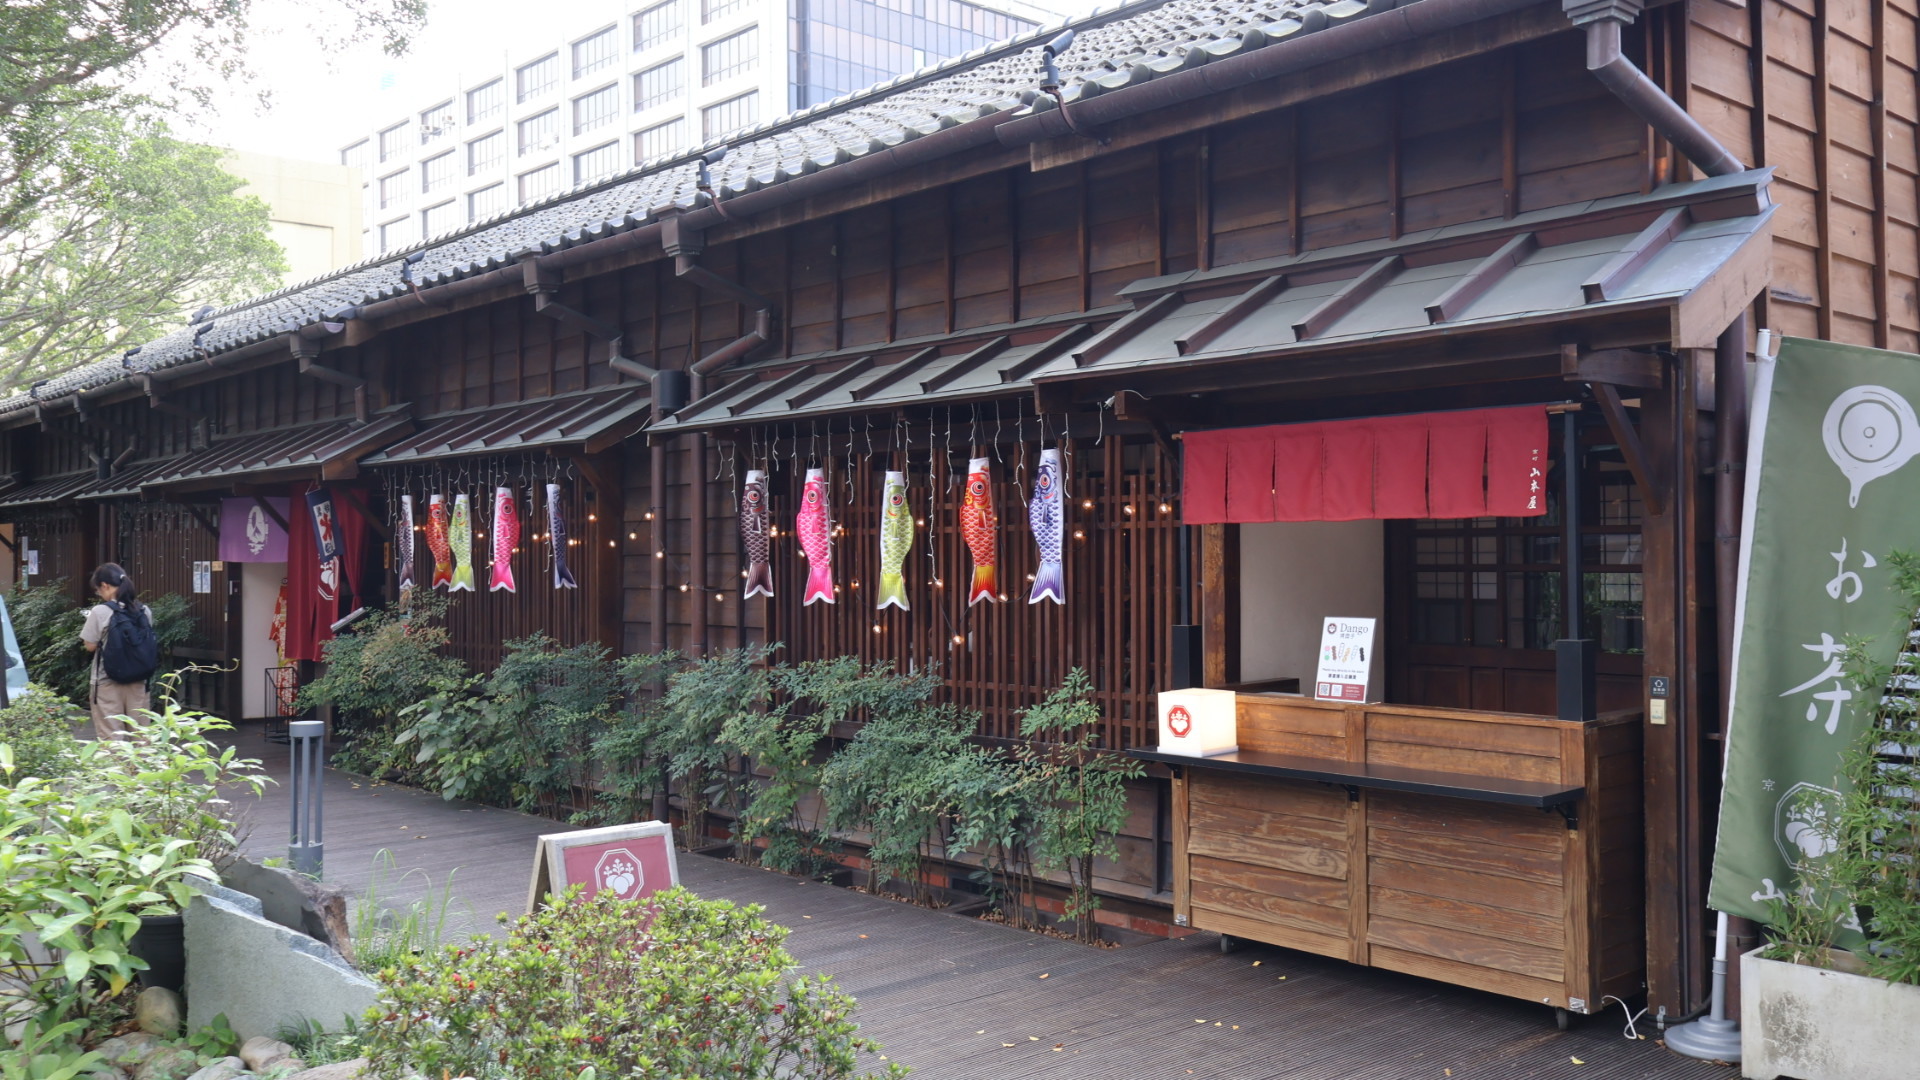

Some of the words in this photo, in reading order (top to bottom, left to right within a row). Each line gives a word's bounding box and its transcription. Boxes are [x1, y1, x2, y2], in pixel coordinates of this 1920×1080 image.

[1527, 467, 1540, 509] 山本屋
[1340, 622, 1369, 635] Dango
[1778, 536, 1877, 735] お茶
